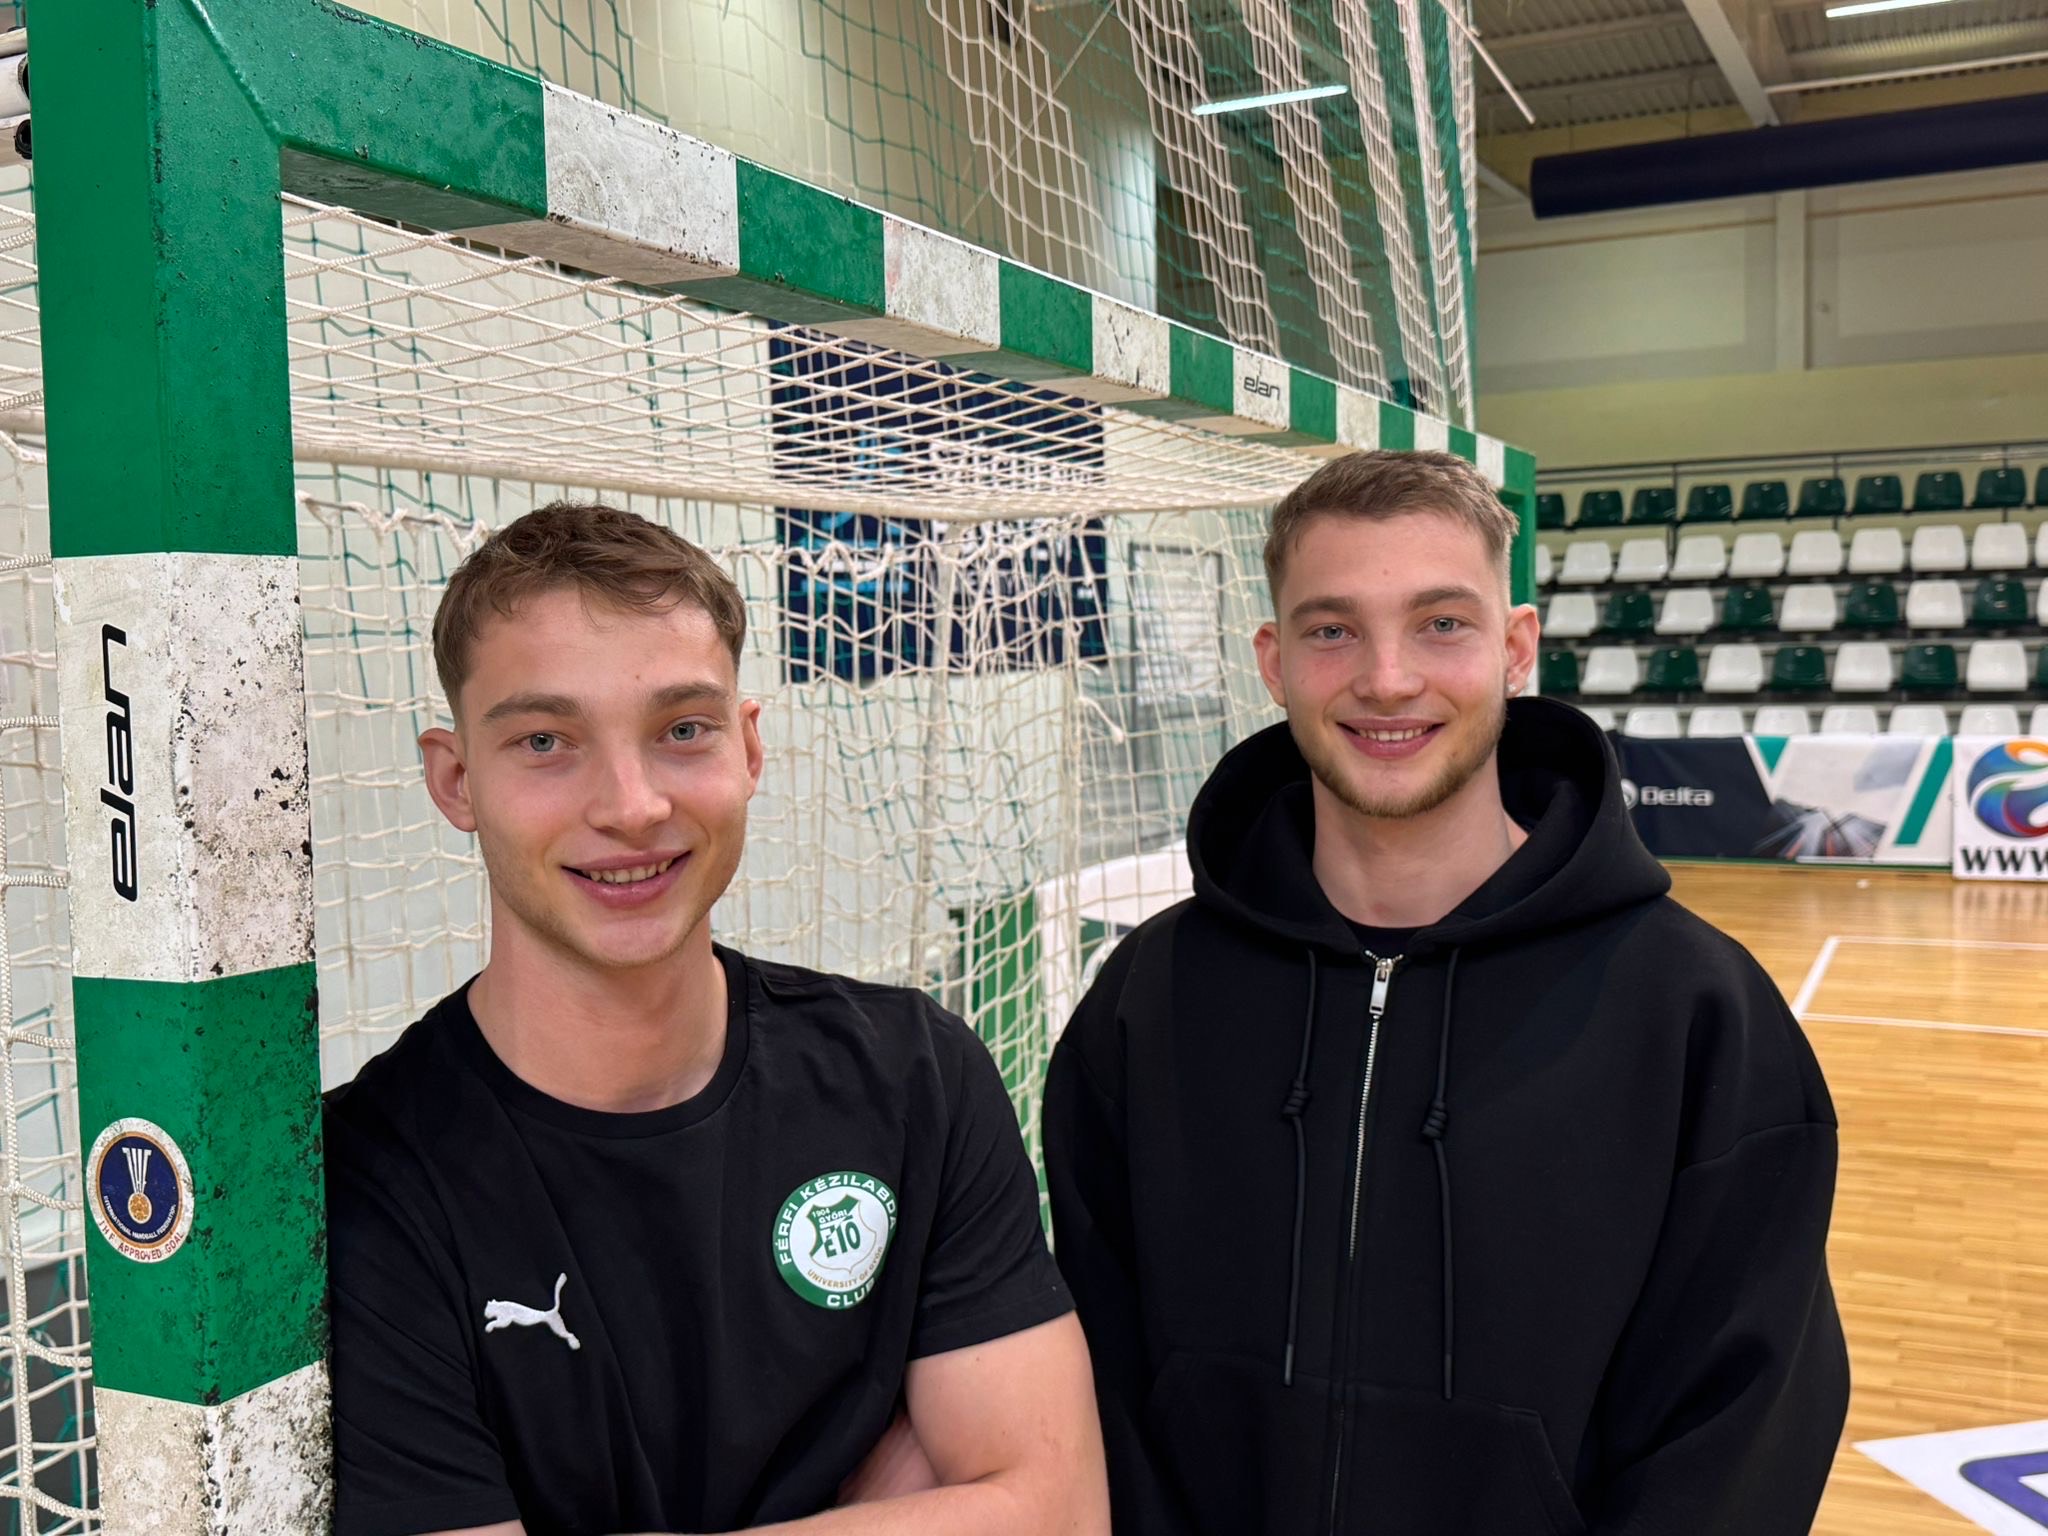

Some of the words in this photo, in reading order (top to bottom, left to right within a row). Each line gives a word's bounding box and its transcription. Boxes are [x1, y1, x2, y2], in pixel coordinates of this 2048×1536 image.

[1243, 375, 1281, 401] elan
[100, 623, 138, 903] elan
[1640, 786, 1715, 807] Delta
[774, 1202, 799, 1265] FÉRFI
[799, 1174, 898, 1231] KÉZILABDA
[118, 1242, 163, 1261] APPROVED
[165, 1231, 185, 1254] GOAL
[807, 1269, 857, 1288] UNIVERSITY
